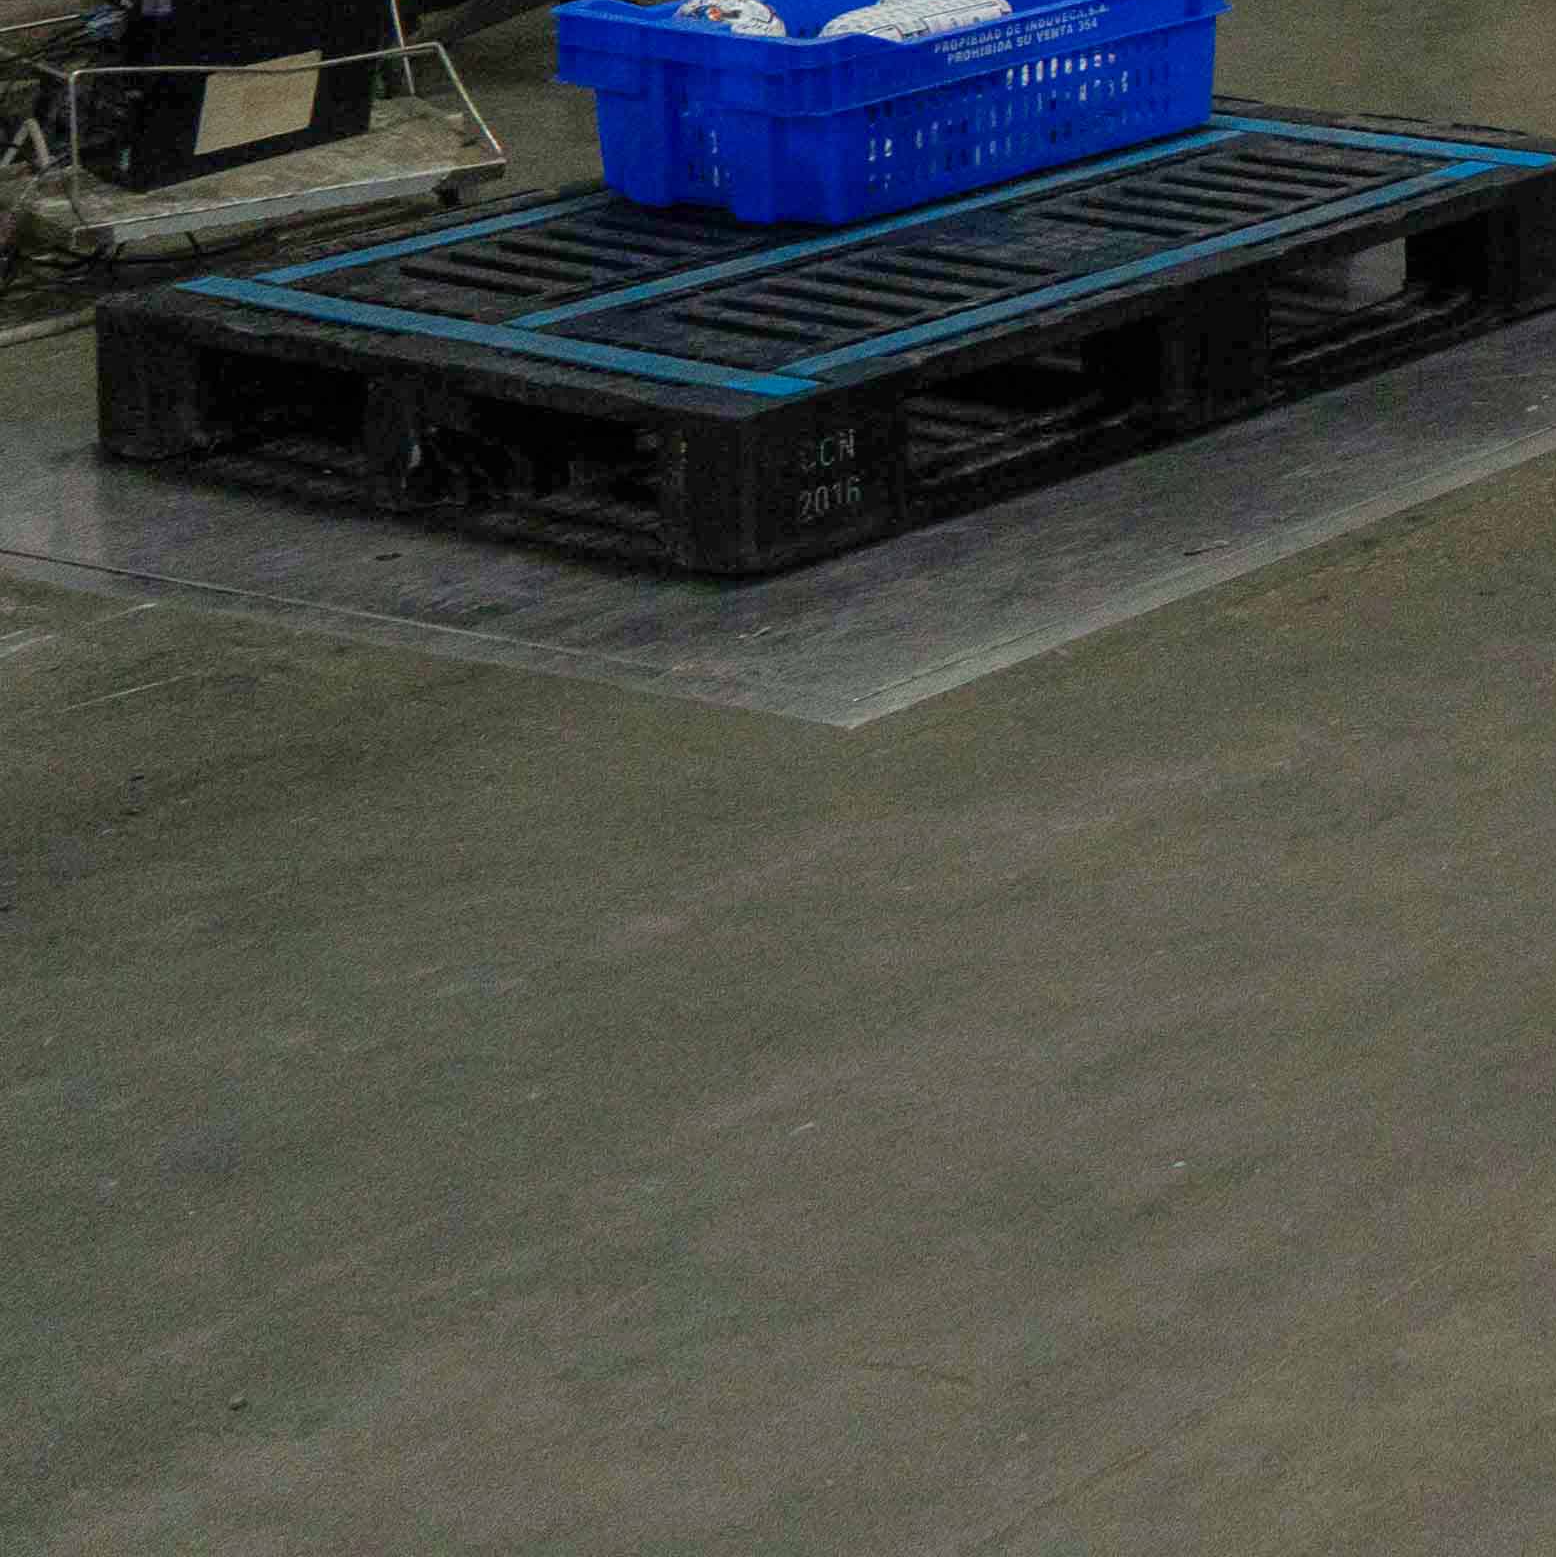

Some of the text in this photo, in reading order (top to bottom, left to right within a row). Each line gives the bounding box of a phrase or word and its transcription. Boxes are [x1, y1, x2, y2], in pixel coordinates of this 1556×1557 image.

[934, 28, 1001, 54] PROPIEDAD
[1006, 23, 1021, 35] DE
[947, 40, 1013, 65] PROHIBIDA
[1016, 35, 1032, 47] SU
[1037, 23, 1074, 43] VENTA
